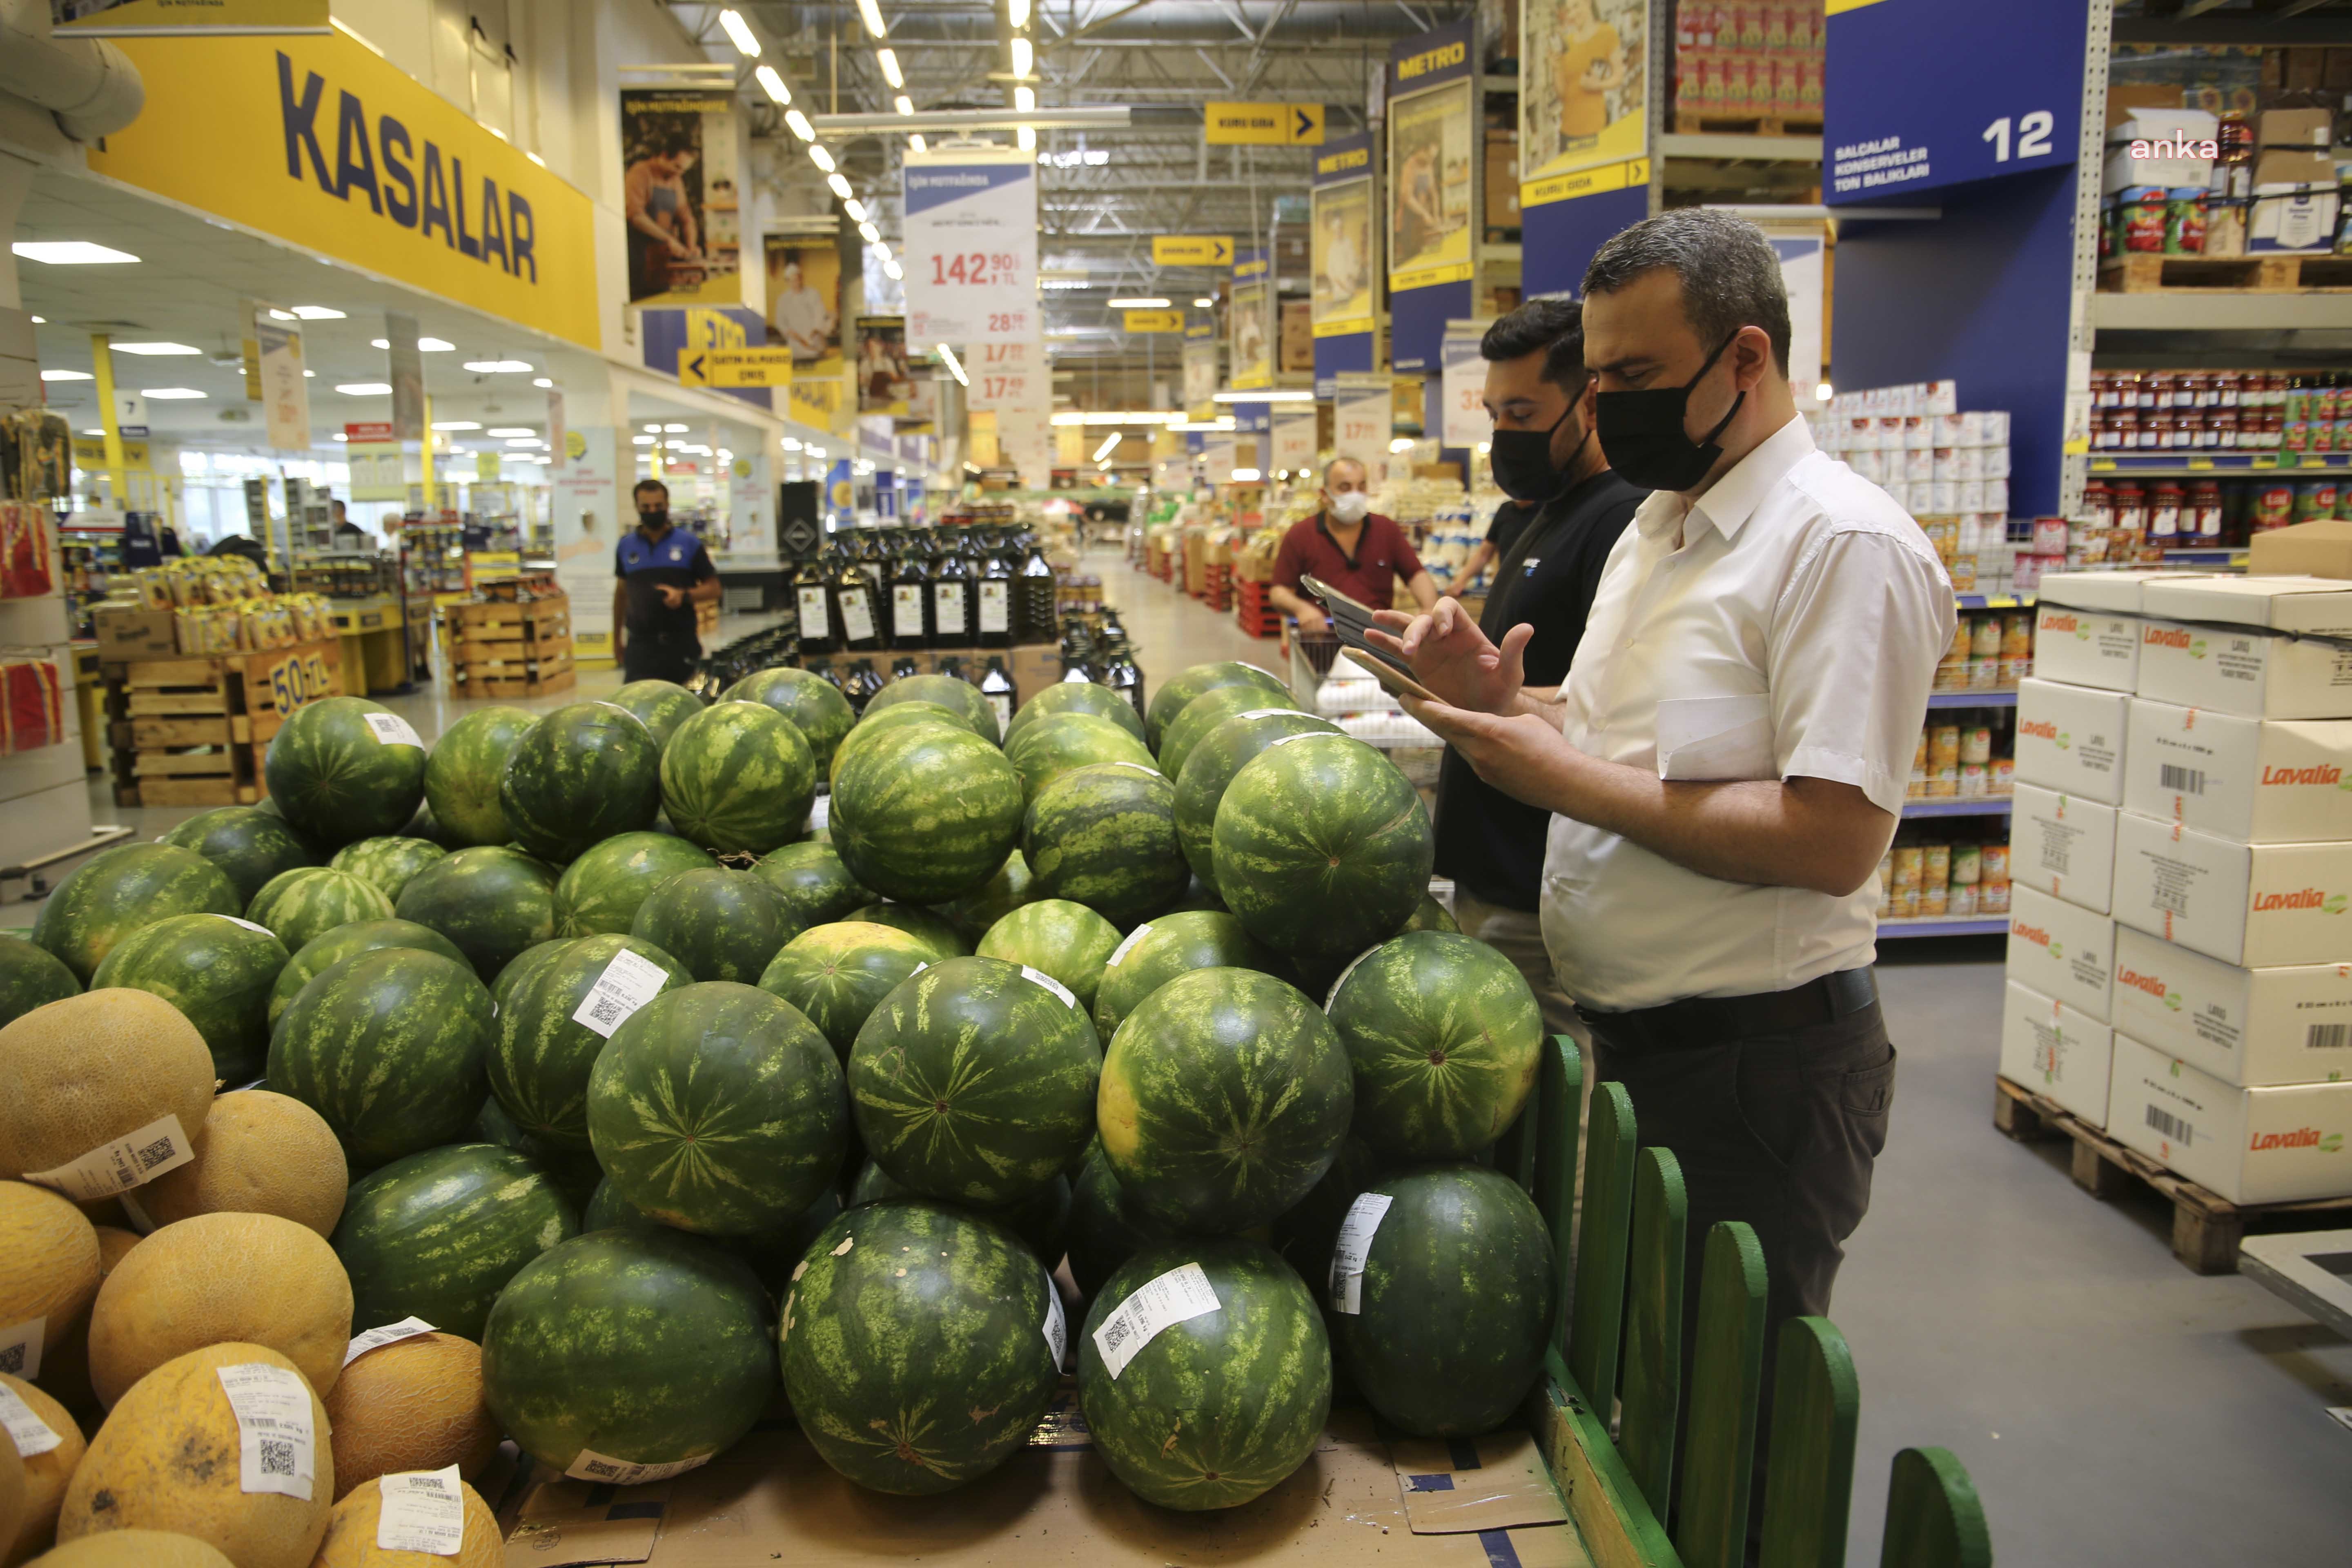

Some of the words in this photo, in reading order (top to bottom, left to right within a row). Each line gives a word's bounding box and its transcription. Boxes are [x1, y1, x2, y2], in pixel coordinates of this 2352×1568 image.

[1398, 41, 1465, 80] METRO
[1219, 118, 1247, 128] KURU
[1982, 110, 2054, 163] 12
[276, 48, 537, 285] KASALAR
[1318, 148, 1368, 174] METRO
[1834, 147, 1928, 177] KONSERVELER
[1535, 181, 1563, 198] KURU
[1567, 177, 1591, 192] GIDA
[1834, 176, 1861, 192] TON
[1863, 163, 1930, 188] BALIKLARI
[125, 401, 135, 414] 7
[2040, 612, 2077, 632] Lavalia
[2144, 626, 2191, 649] Lavalia
[273, 660, 304, 714] 50
[309, 659, 329, 690] TL
[2019, 717, 2057, 740] Lavalia
[2262, 763, 2342, 785] Lavalia
[2253, 887, 2325, 911] Lavalia
[2012, 919, 2050, 947] Lavalia
[2118, 964, 2166, 997] Lavalia
[2251, 1126, 2321, 1150] Lavalia
